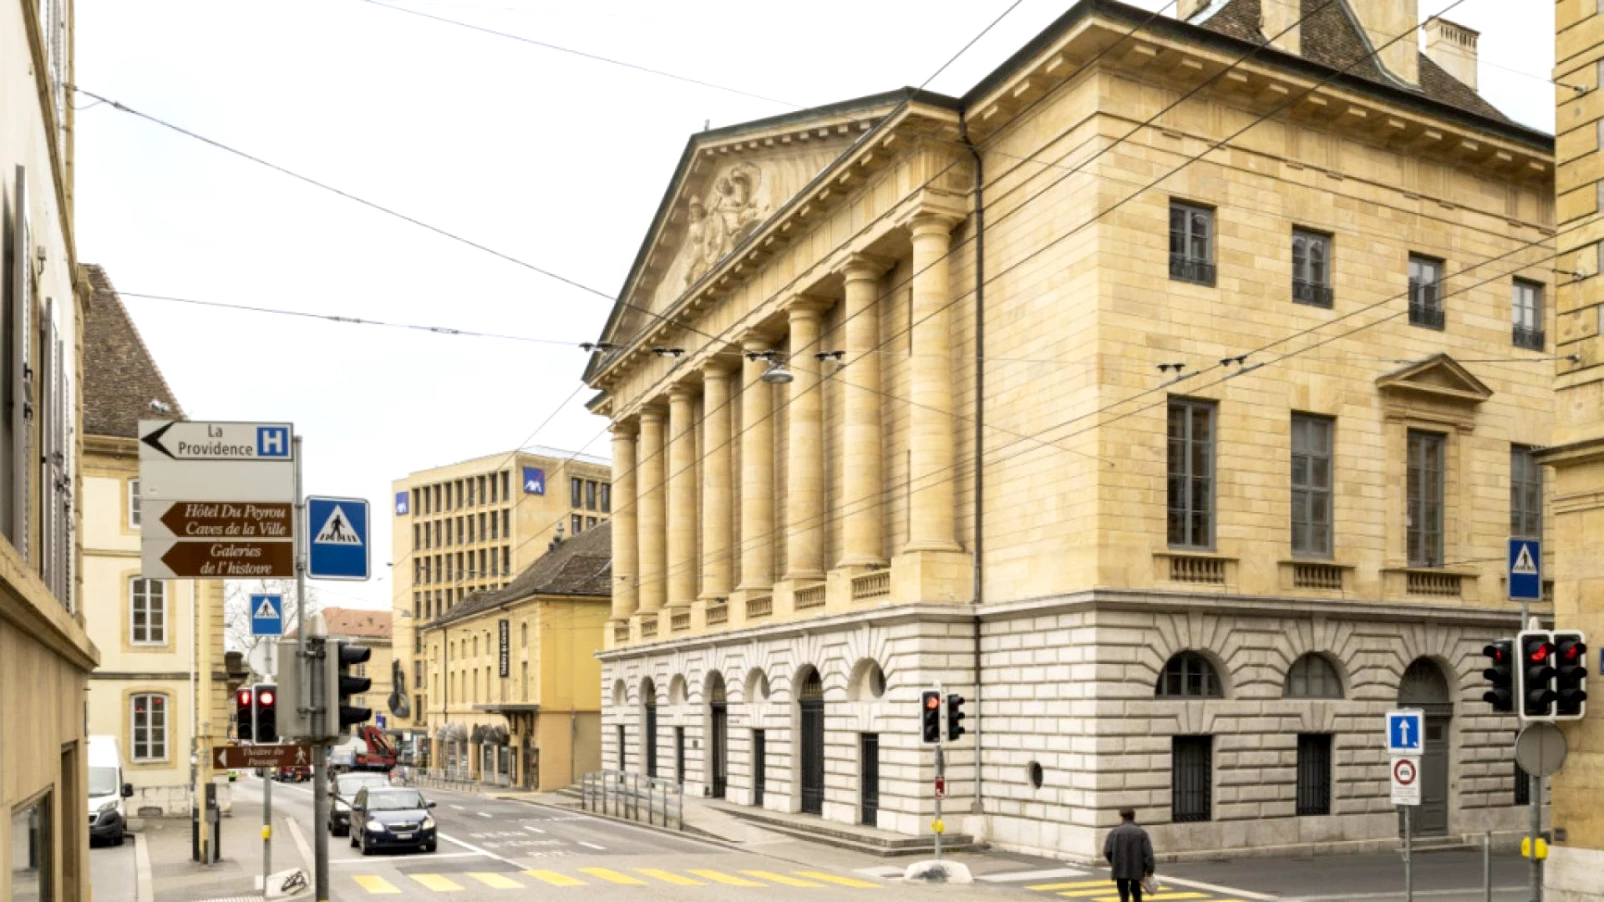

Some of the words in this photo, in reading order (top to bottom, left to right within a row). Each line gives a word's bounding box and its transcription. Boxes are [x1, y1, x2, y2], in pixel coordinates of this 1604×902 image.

[207, 424, 223, 438] La
[178, 441, 253, 455] Providence
[185, 503, 219, 518] Hôtel
[221, 504, 242, 518] Du
[243, 504, 286, 521] Peyrou
[186, 521, 223, 535] Caves
[225, 522, 240, 535] de
[242, 522, 255, 535] la
[260, 522, 286, 535] Ville
[210, 543, 262, 557] Galeries
[200, 561, 216, 574] de
